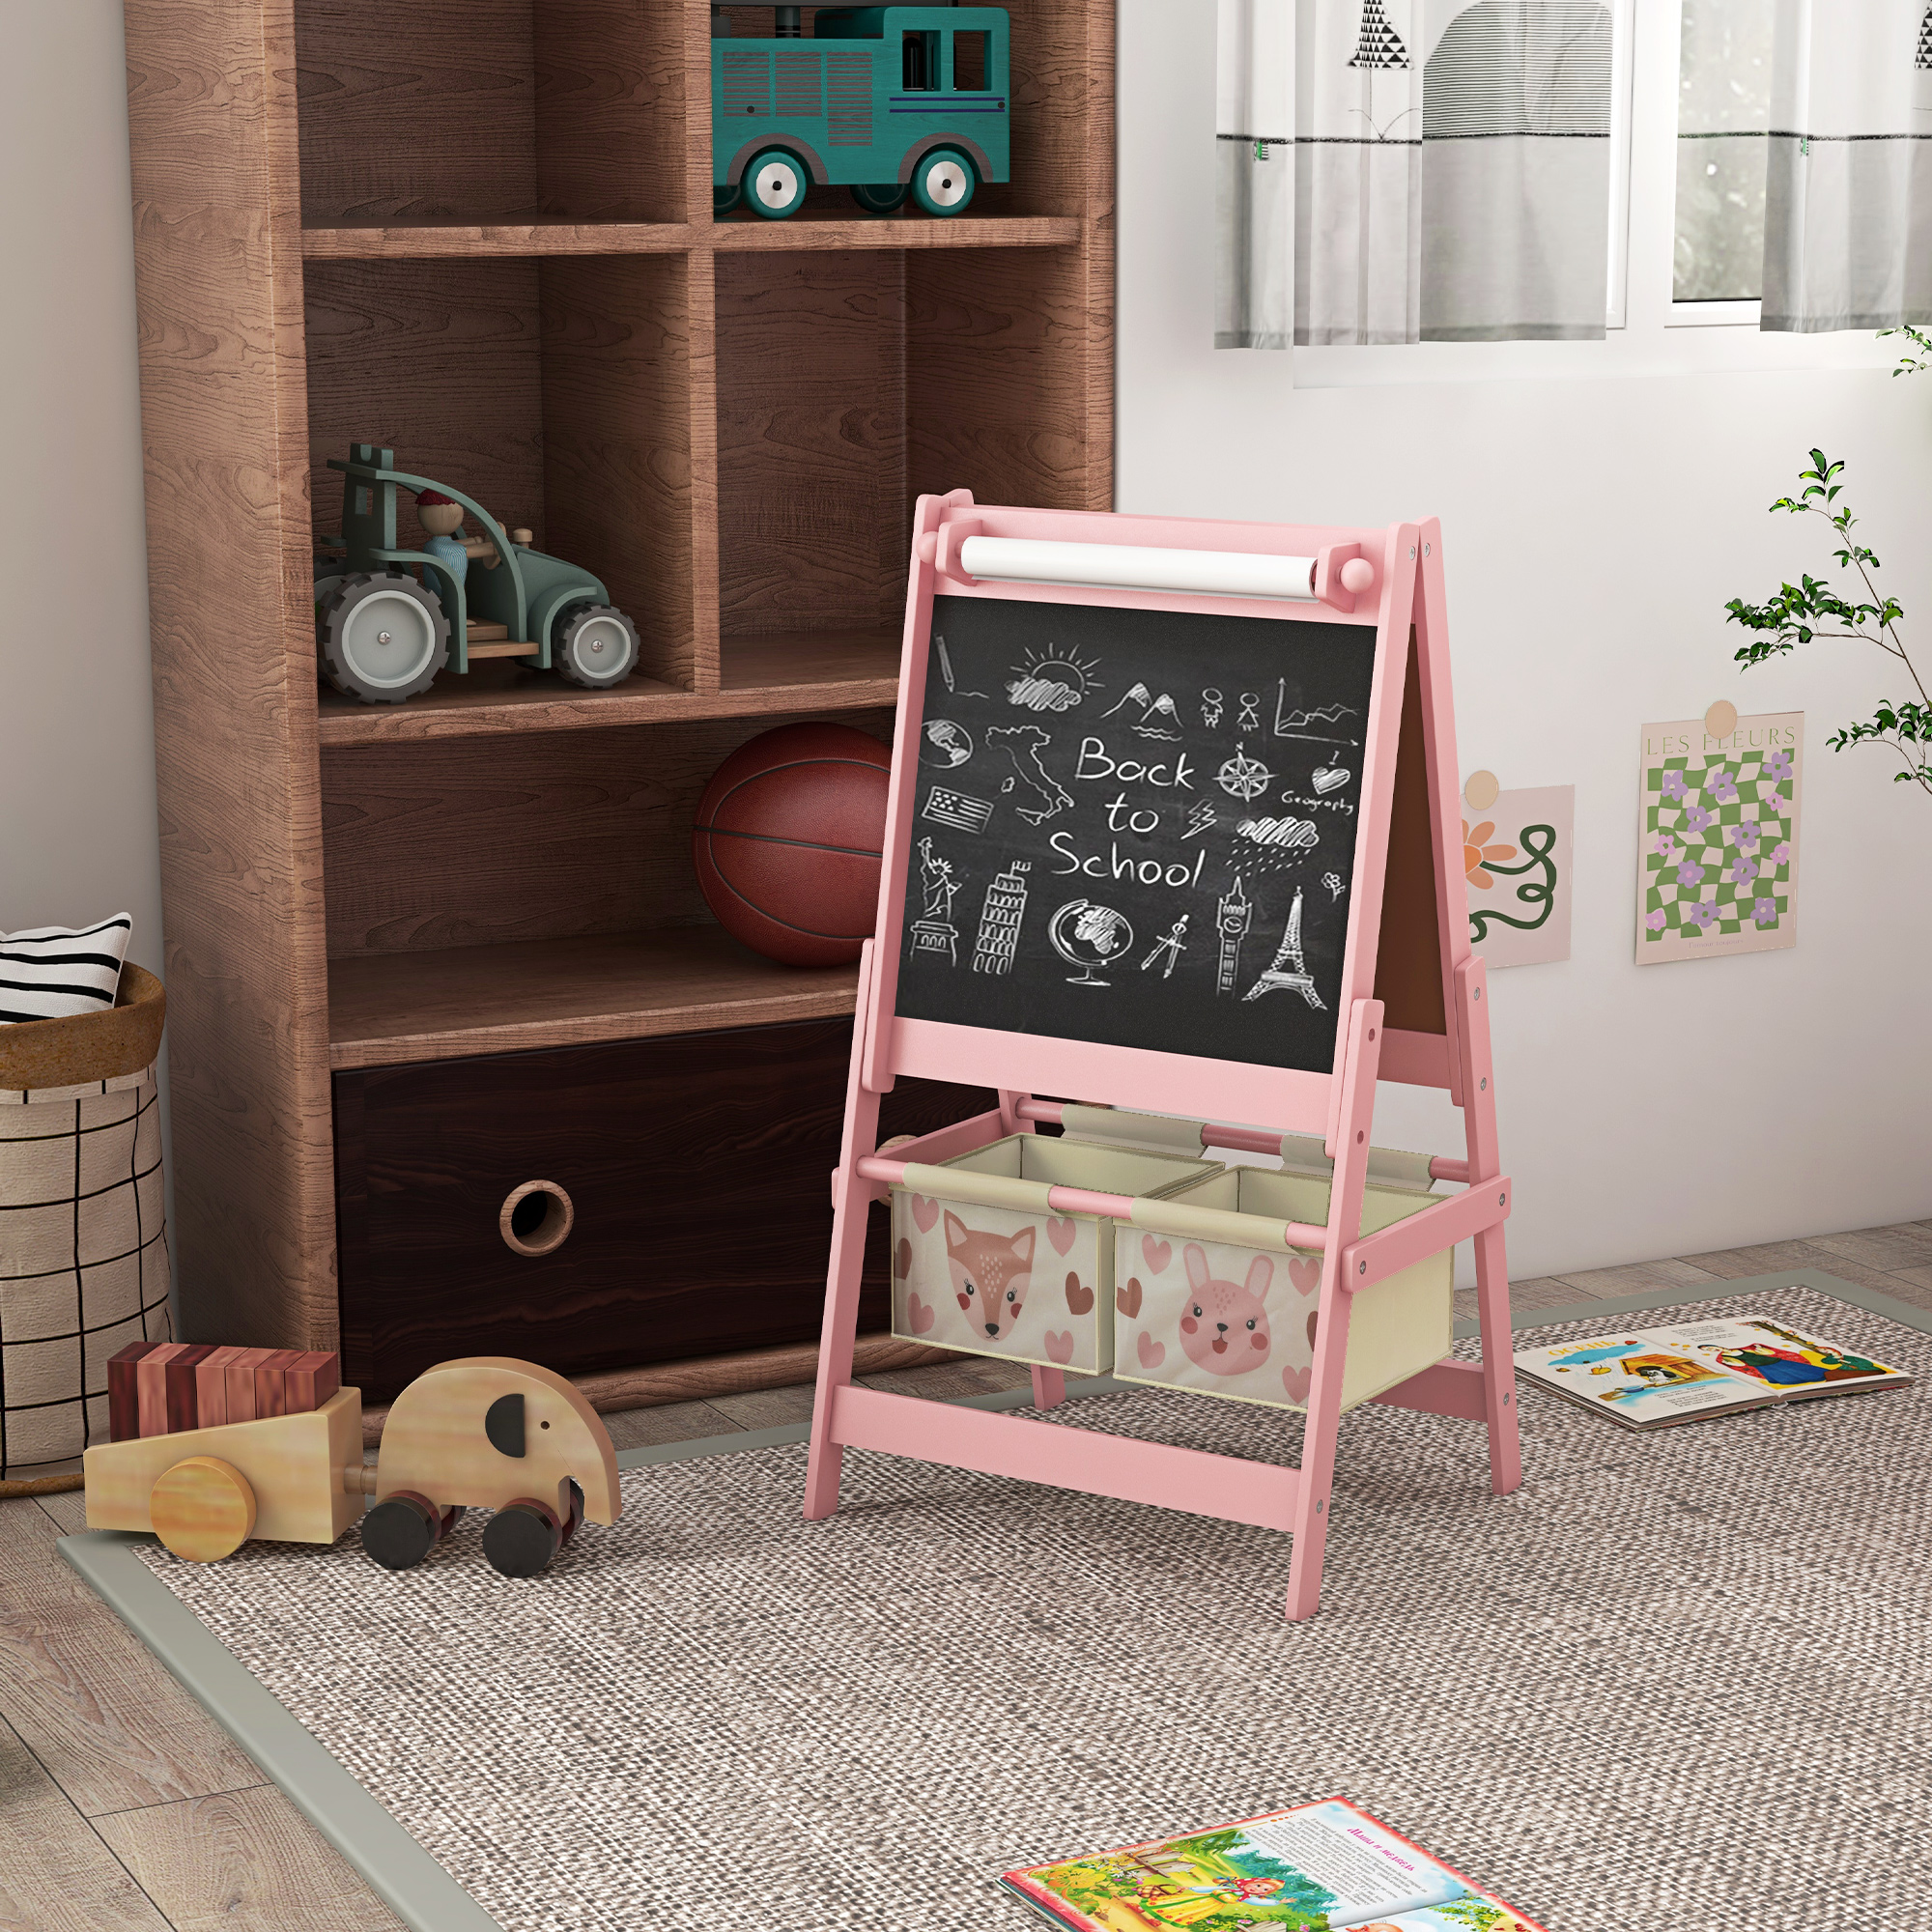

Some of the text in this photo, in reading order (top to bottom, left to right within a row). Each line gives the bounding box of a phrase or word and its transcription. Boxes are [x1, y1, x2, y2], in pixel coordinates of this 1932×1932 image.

[1647, 725, 1796, 755] LES FLEURS
[1074, 736, 1195, 790] Back
[1104, 791, 1159, 833] to
[1280, 789, 1354, 816] Geography
[1049, 831, 1206, 888] School
[1548, 1339, 1617, 1356] ОСЕНЬ
